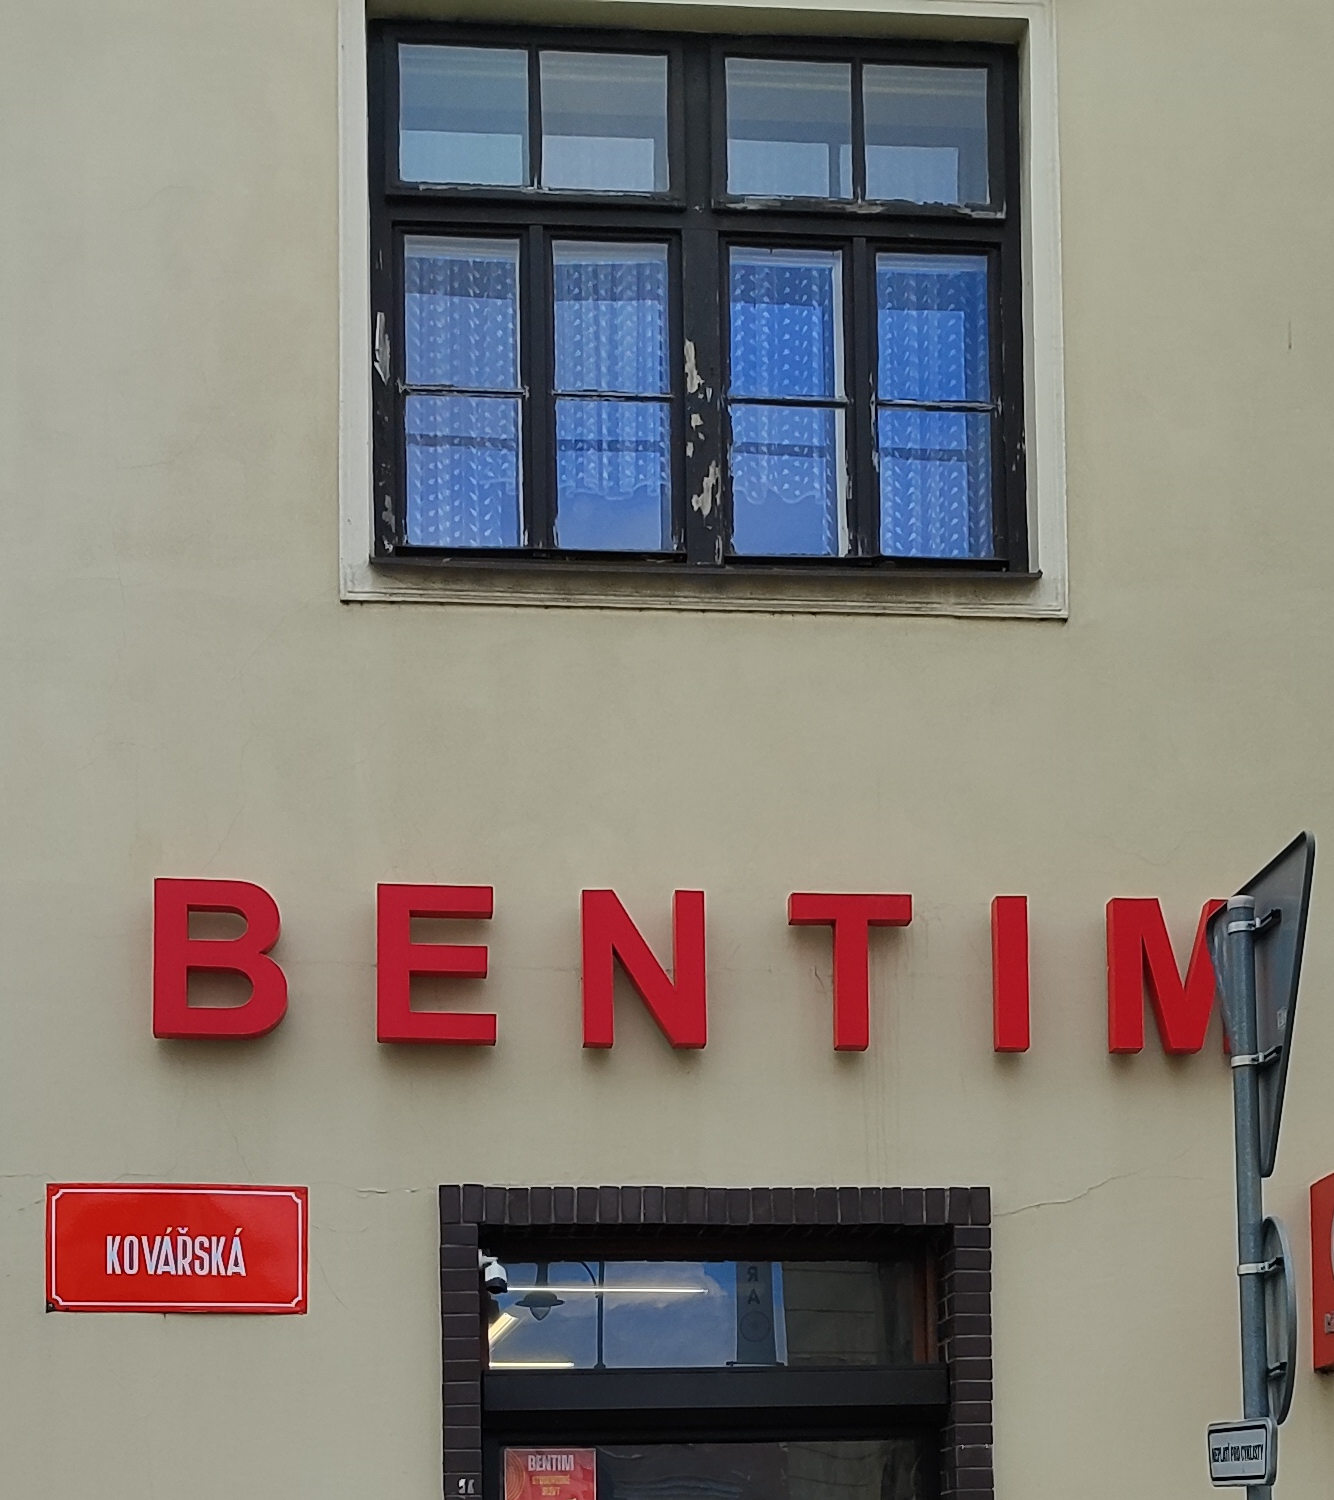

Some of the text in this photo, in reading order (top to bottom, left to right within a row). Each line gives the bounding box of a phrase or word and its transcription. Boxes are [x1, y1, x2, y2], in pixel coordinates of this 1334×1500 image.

[153, 877, 1233, 1055] BENTIM
[106, 1227, 247, 1277] KOVÁŘSKÁ
[528, 1454, 574, 1471] BENTIM
